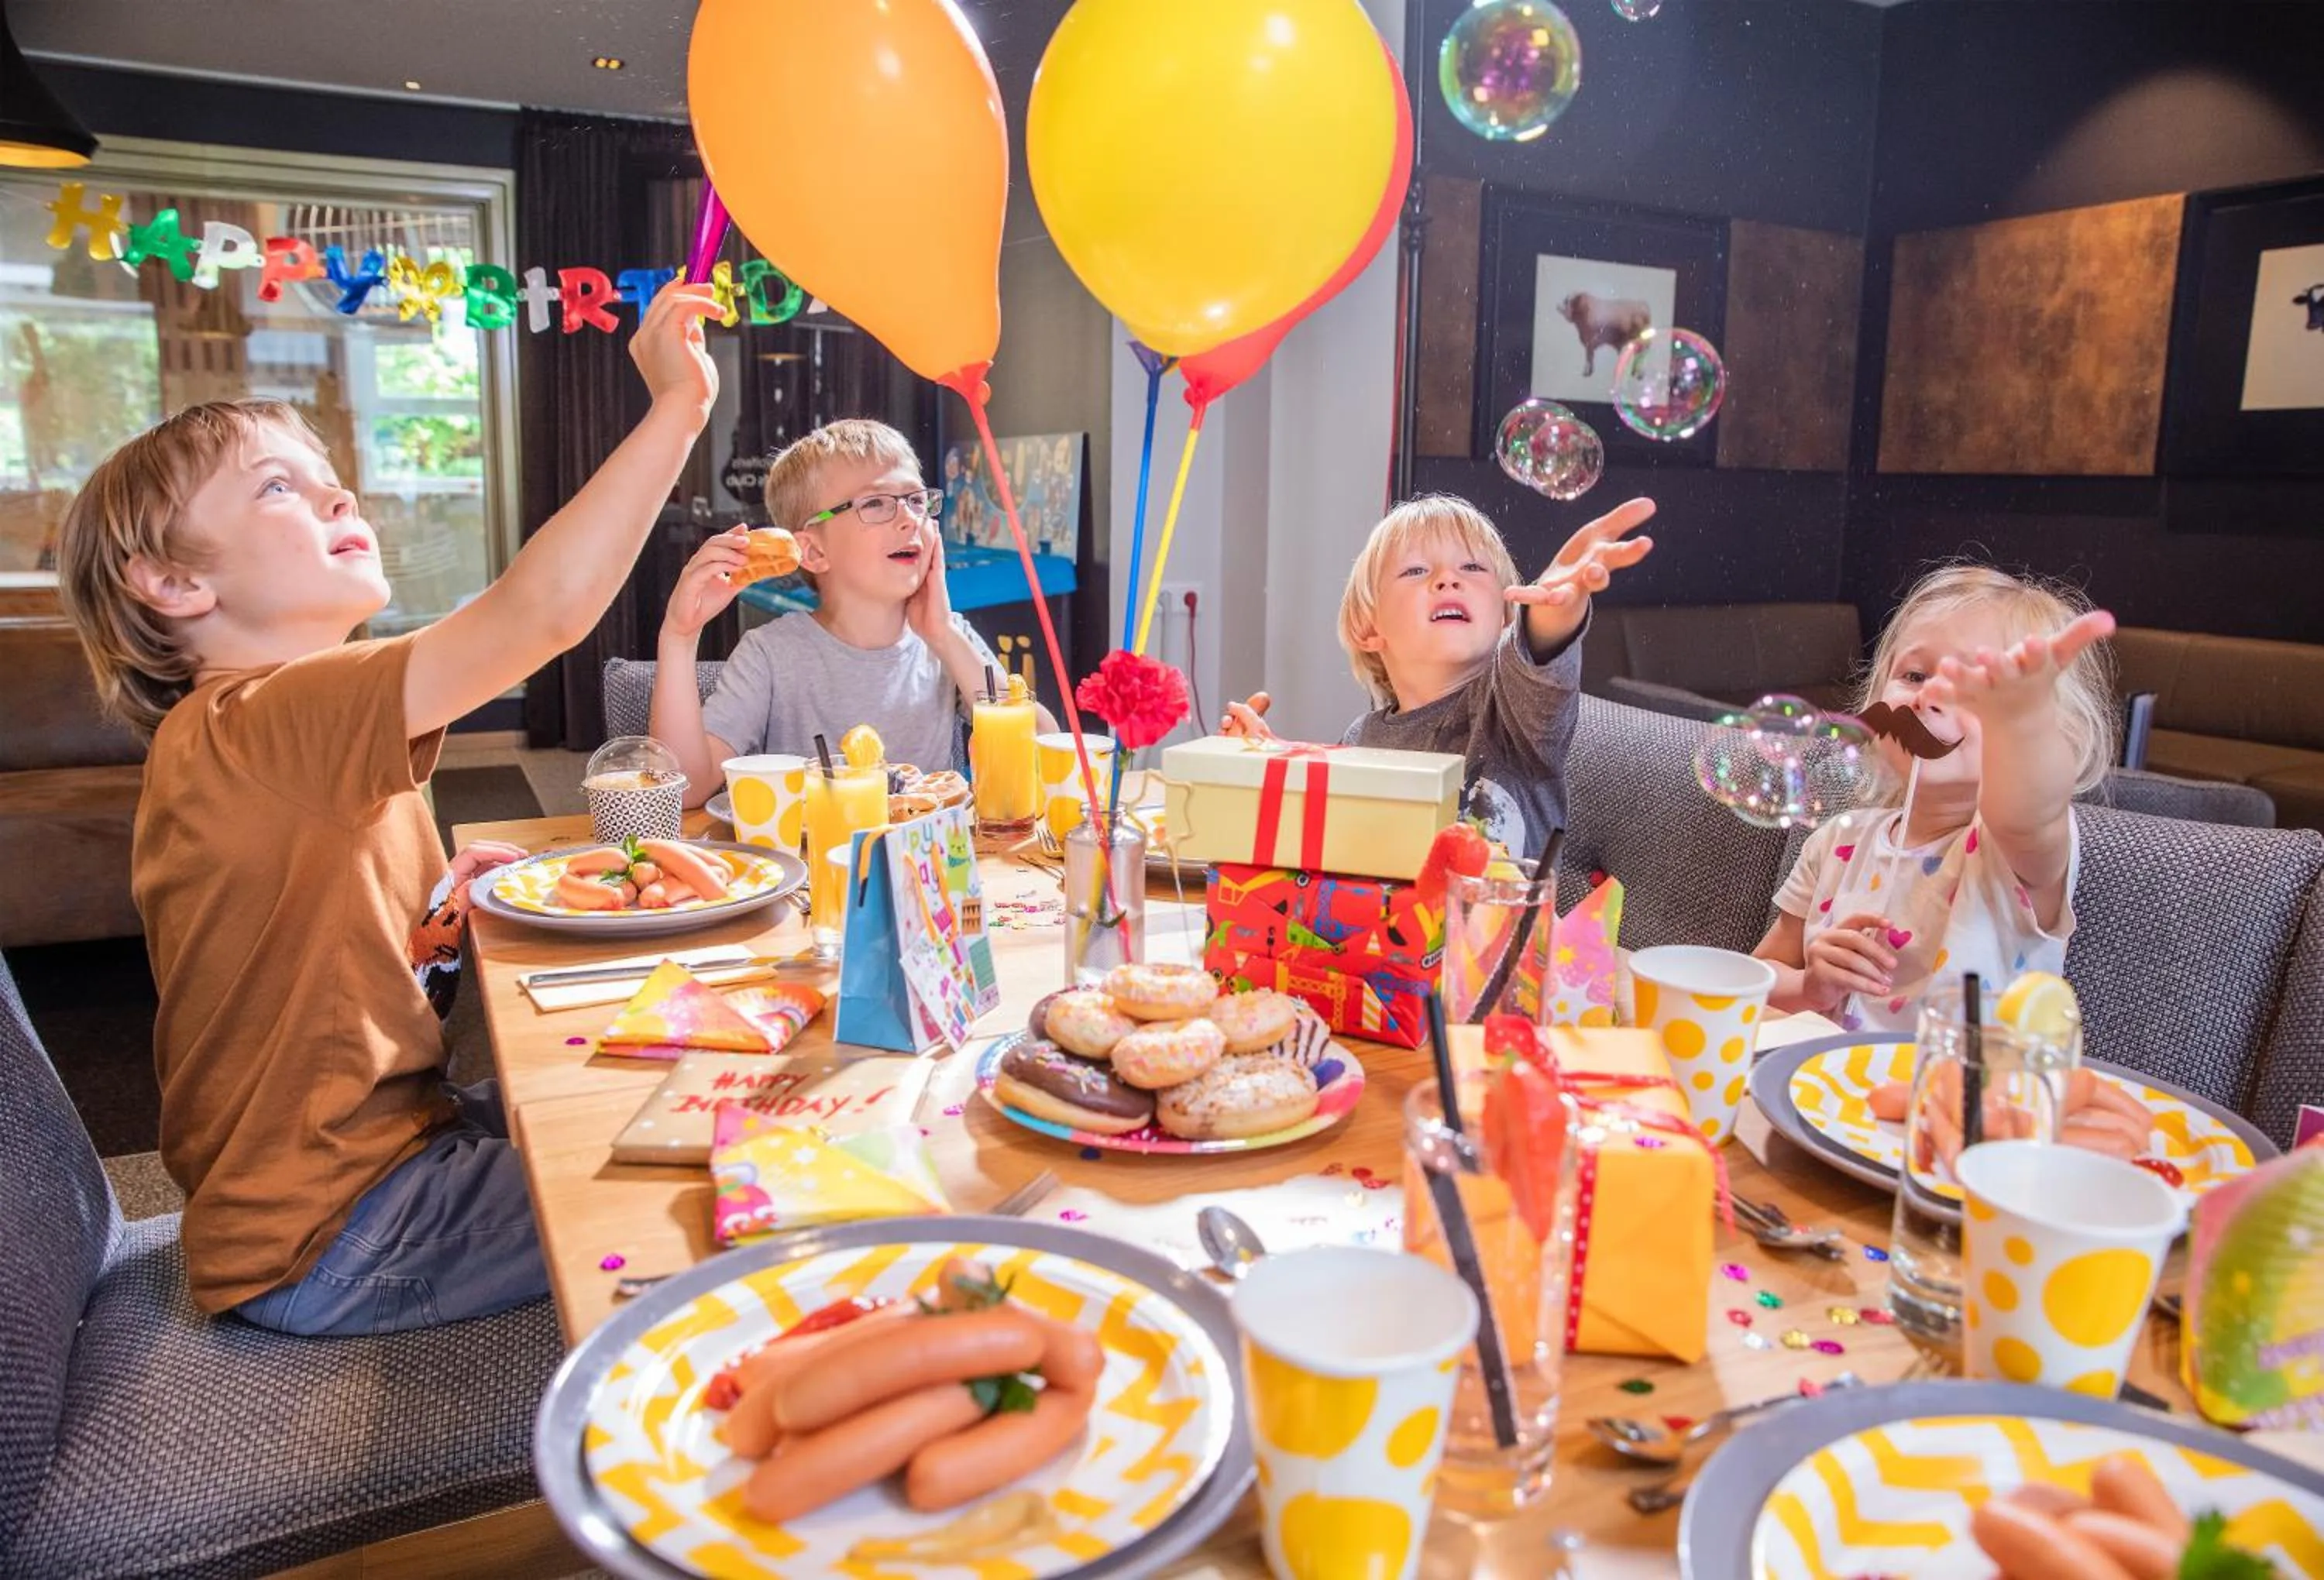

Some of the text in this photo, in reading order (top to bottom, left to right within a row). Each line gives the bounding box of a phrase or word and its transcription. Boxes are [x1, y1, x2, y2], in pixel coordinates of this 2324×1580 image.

[44, 181, 828, 335] HAPPY BIRTD
[708, 1071, 810, 1094] HAPPY
